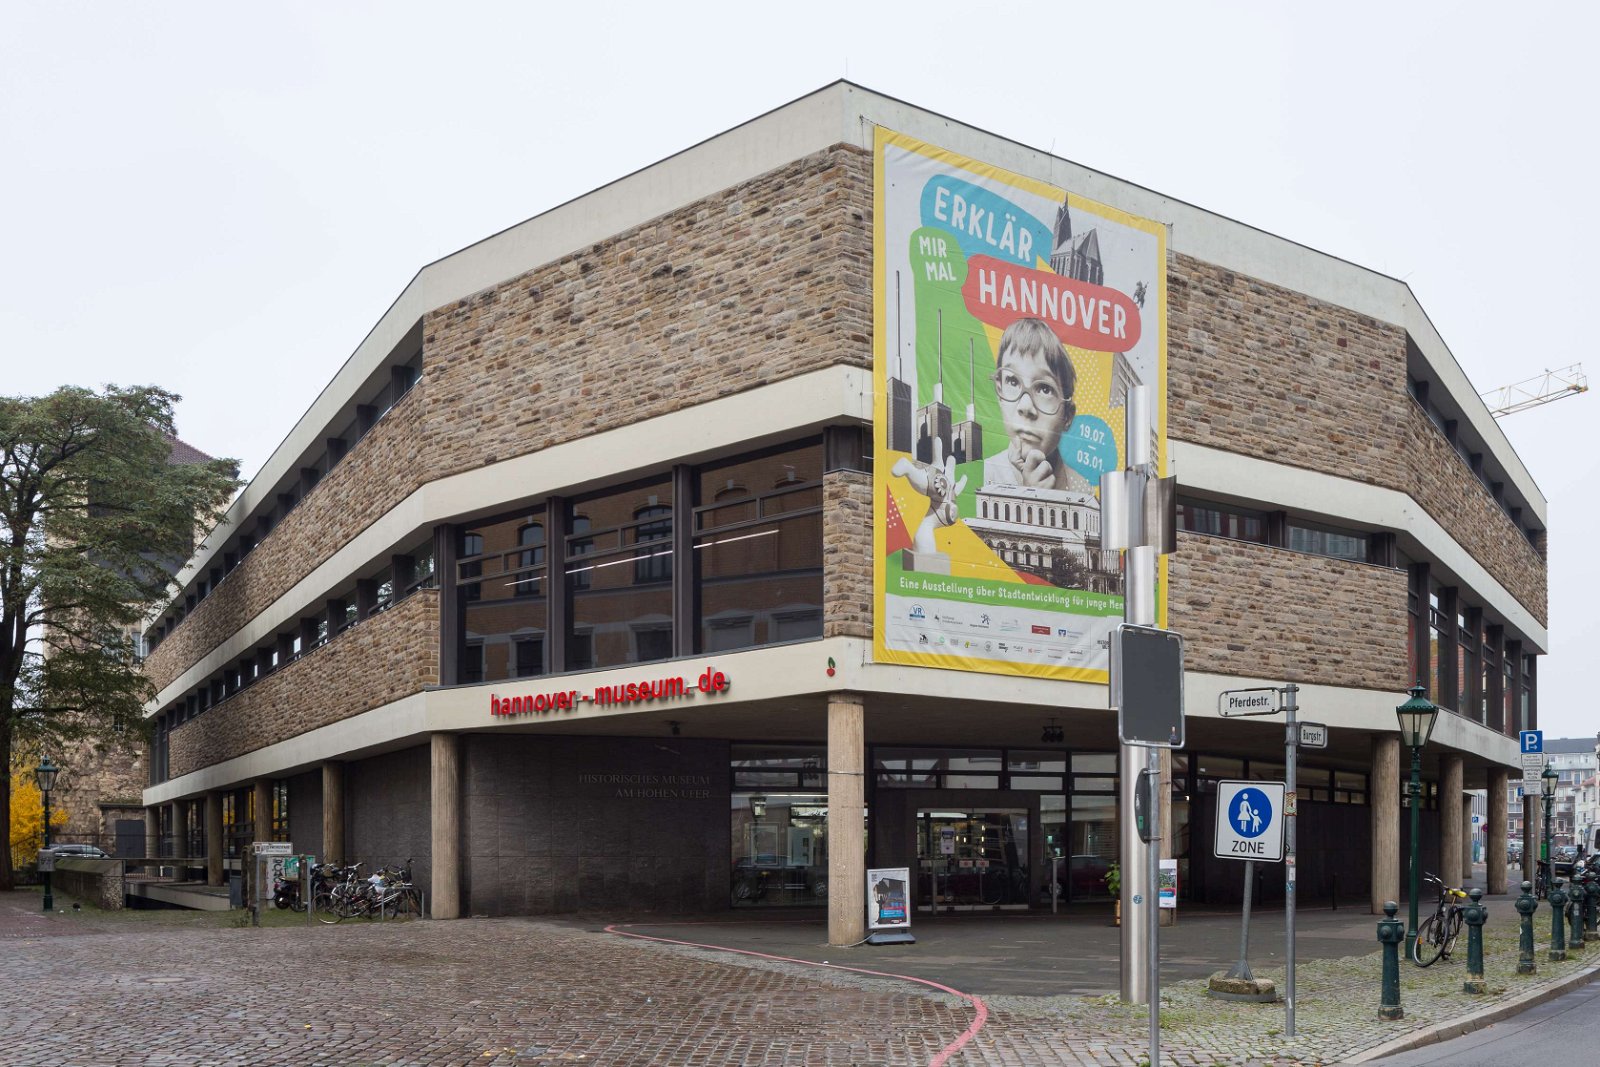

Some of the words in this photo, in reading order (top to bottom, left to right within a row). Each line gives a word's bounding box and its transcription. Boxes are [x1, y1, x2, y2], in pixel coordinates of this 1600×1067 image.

[934, 186, 1033, 262] ERKLÄR
[919, 235, 948, 258] MIR
[925, 261, 957, 282] MAL
[978, 268, 1127, 340] HANNOVER
[1079, 423, 1105, 446] 19.07.
[1077, 450, 1105, 473] 03.01.
[900, 577, 919, 590] Eine
[922, 579, 974, 599] Ausstellung
[976, 585, 996, 597] über
[998, 587, 1070, 608] Stadtentwicklung
[1072, 595, 1084, 606] für
[1086, 597, 1107, 611] junge
[1229, 696, 1270, 708] Pferdestr.
[1302, 729, 1323, 743] Burgstr.
[1525, 733, 1538, 751] P
[579, 774, 659, 784] HISTORISCHES
[661, 775, 710, 785] MUSEUM
[616, 789, 633, 798] AM
[637, 789, 678, 798] HOHEN
[680, 789, 710, 799] UFER
[1231, 840, 1265, 854] ZONE
